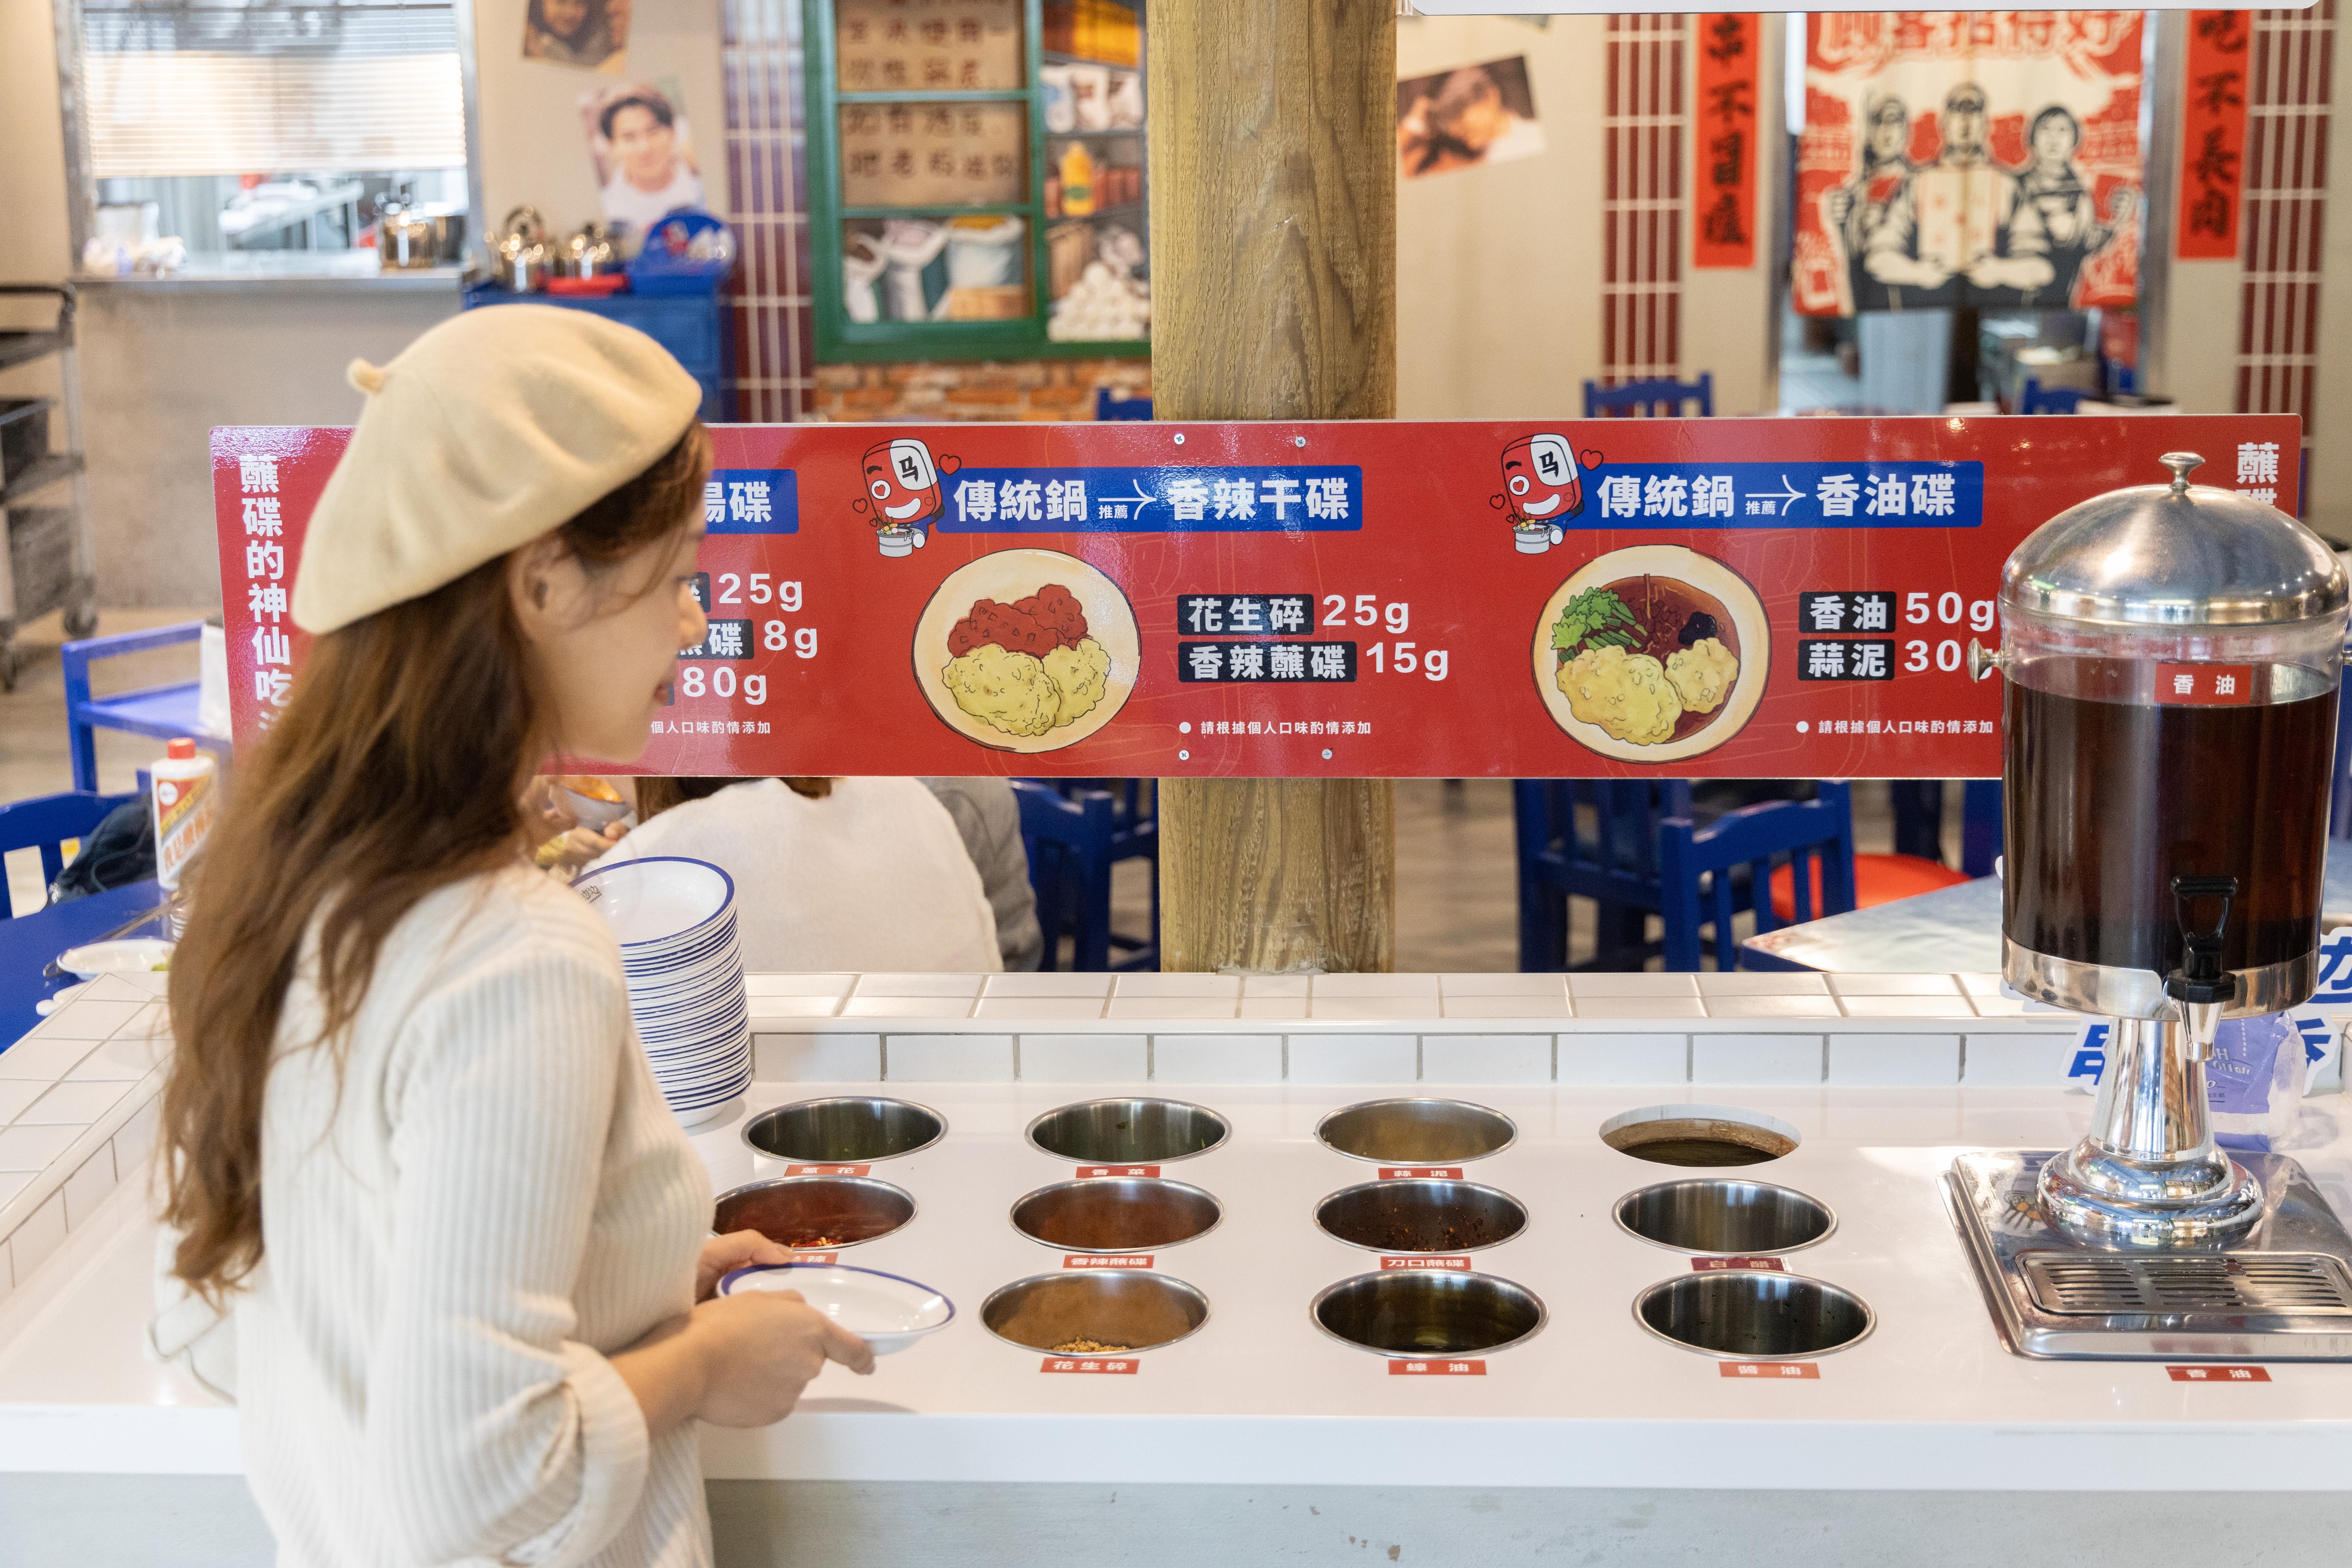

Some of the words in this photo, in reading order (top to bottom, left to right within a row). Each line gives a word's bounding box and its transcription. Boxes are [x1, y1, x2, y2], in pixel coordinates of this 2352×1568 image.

[898, 455, 919, 483] 马
[1538, 450, 1559, 478] 马
[953, 479, 1087, 522] 傳統鍋
[1099, 504, 1128, 519] 推薦
[1168, 478, 1349, 520] 香辣干碟
[1597, 474, 1734, 518] 傳統鍋
[1745, 500, 1776, 515] 推薦
[1816, 473, 1955, 516] 香油碟
[239, 454, 292, 730] 蘸碟的神仙吃
[718, 573, 803, 612] 25g
[1188, 598, 1304, 632] 花生碎
[1322, 594, 1409, 633] 25g
[1810, 595, 1887, 630] 香油
[1905, 592, 1994, 632] 50g
[764, 620, 818, 659] 8g
[1189, 645, 1346, 679] 香辣蘸碟
[1366, 642, 1448, 681] 15g
[1808, 643, 1886, 677] 蒜泥
[1904, 640, 1993, 679] 30
[682, 666, 767, 705] 80g
[2173, 674, 2235, 695] 香油
[650, 720, 771, 734] 個人口味酌情添加
[1201, 721, 1371, 735] 請根據個人口味酌情添加
[1818, 720, 1993, 734] 請根據個人口味酌情添加
[1053, 1361, 1128, 1371] 花生碎
[2186, 1369, 2252, 1378] 香油
